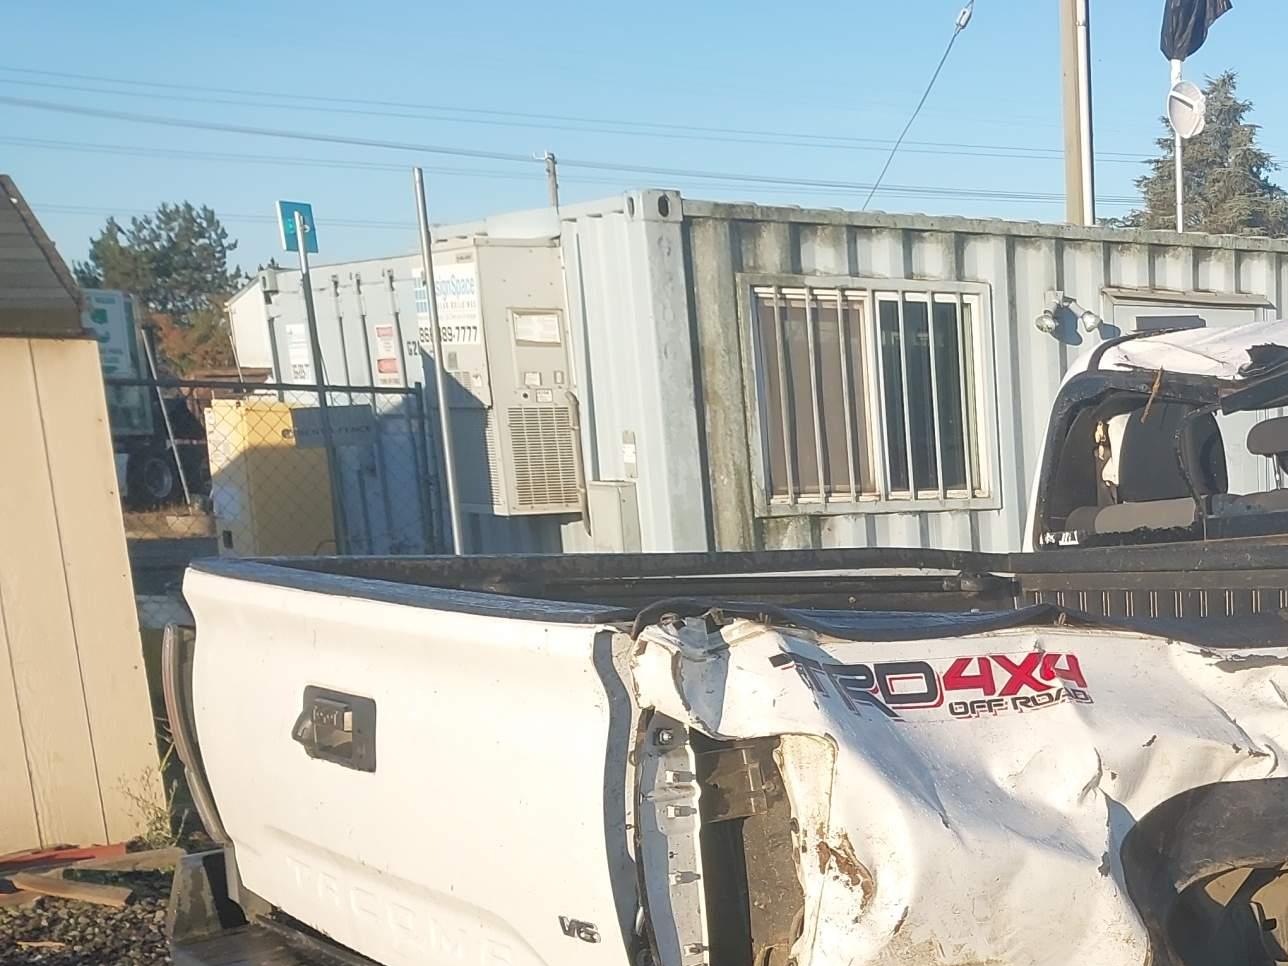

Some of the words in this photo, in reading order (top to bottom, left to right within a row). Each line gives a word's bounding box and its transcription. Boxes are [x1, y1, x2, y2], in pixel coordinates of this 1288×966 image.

[769, 652, 944, 722] TRD
[948, 698, 1008, 719] OFF
[1010, 687, 1095, 711] ROAD
[558, 915, 602, 944] V6
